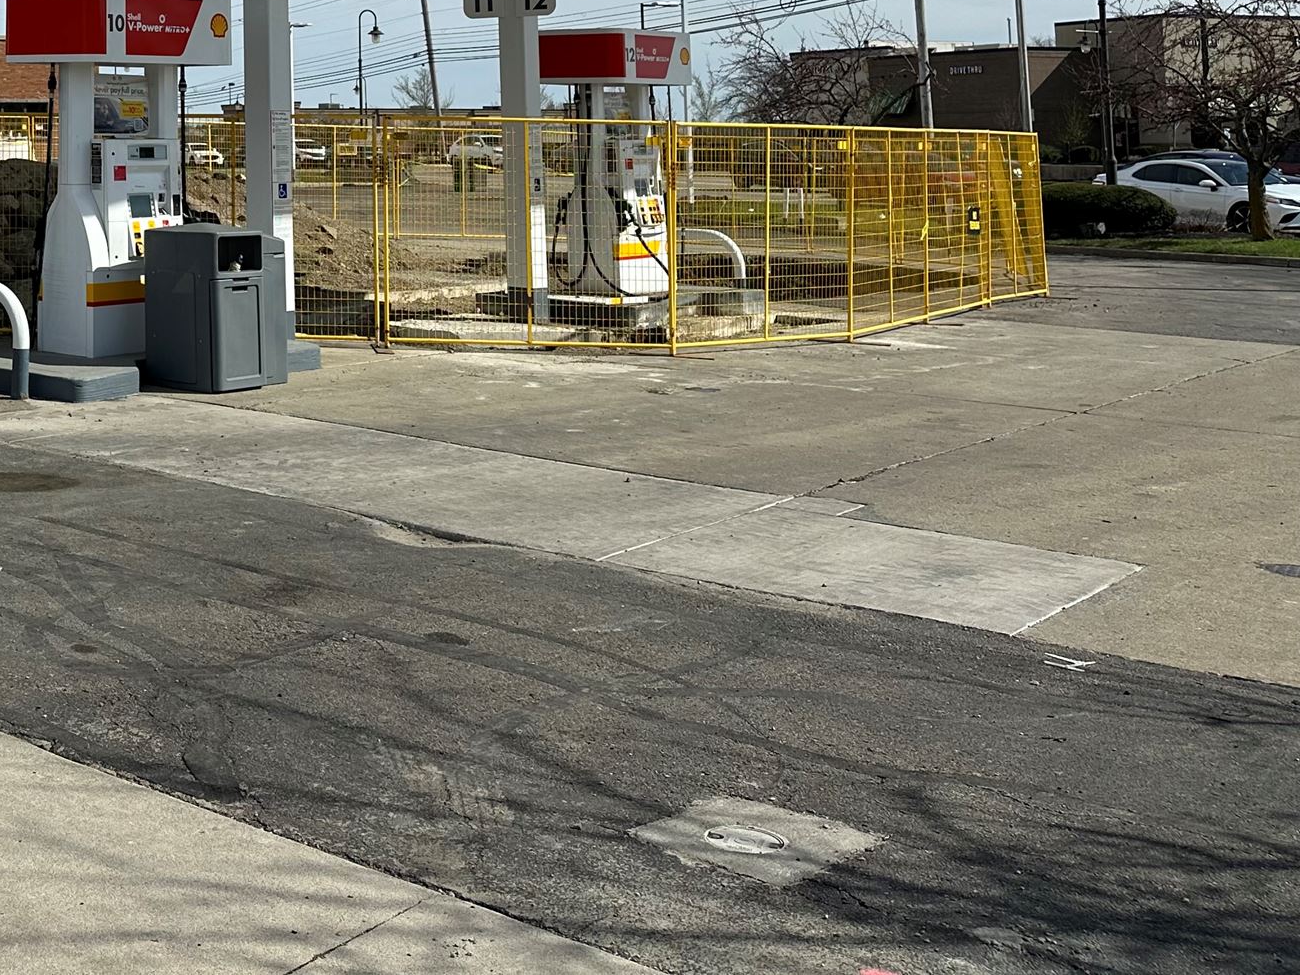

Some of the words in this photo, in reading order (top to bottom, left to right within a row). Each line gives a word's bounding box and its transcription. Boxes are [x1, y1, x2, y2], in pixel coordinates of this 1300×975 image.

[107, 13, 125, 32] 10
[127, 13, 142, 21] Shell
[127, 20, 163, 33] V-Power
[625, 47, 636, 63] 12
